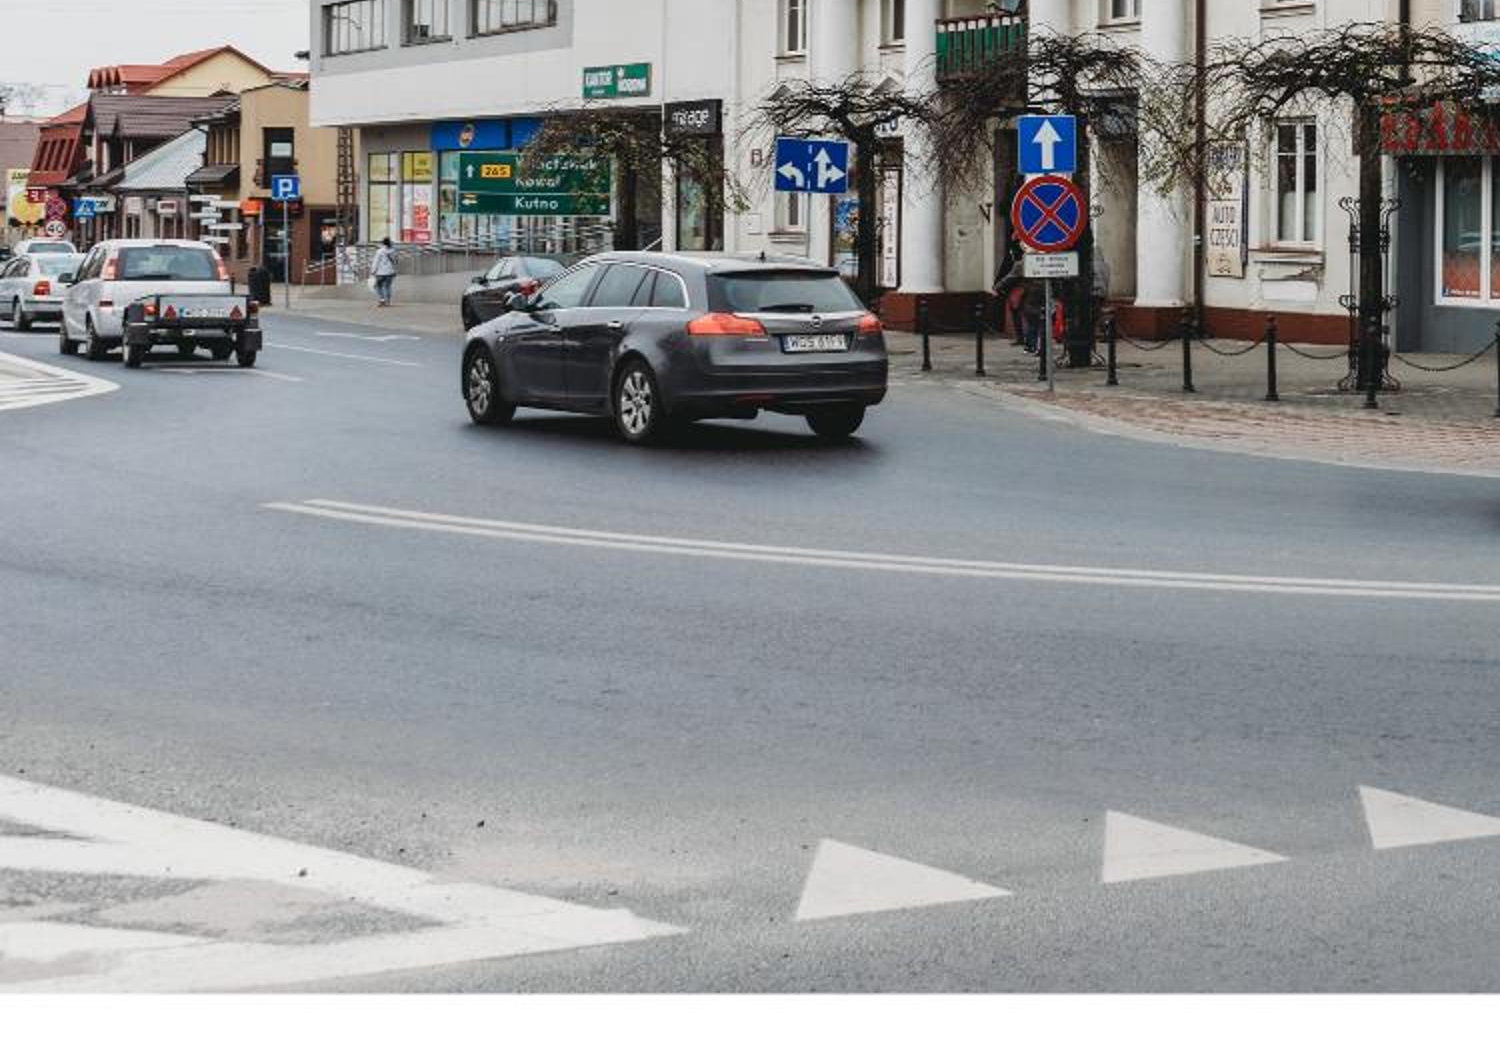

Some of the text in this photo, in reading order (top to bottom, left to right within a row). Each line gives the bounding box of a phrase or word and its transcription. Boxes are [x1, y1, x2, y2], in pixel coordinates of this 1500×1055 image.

[485, 166, 508, 177] 265
[515, 196, 559, 210] Kutno
[1212, 205, 1235, 224] AUTO
[47, 224, 65, 234] 40
